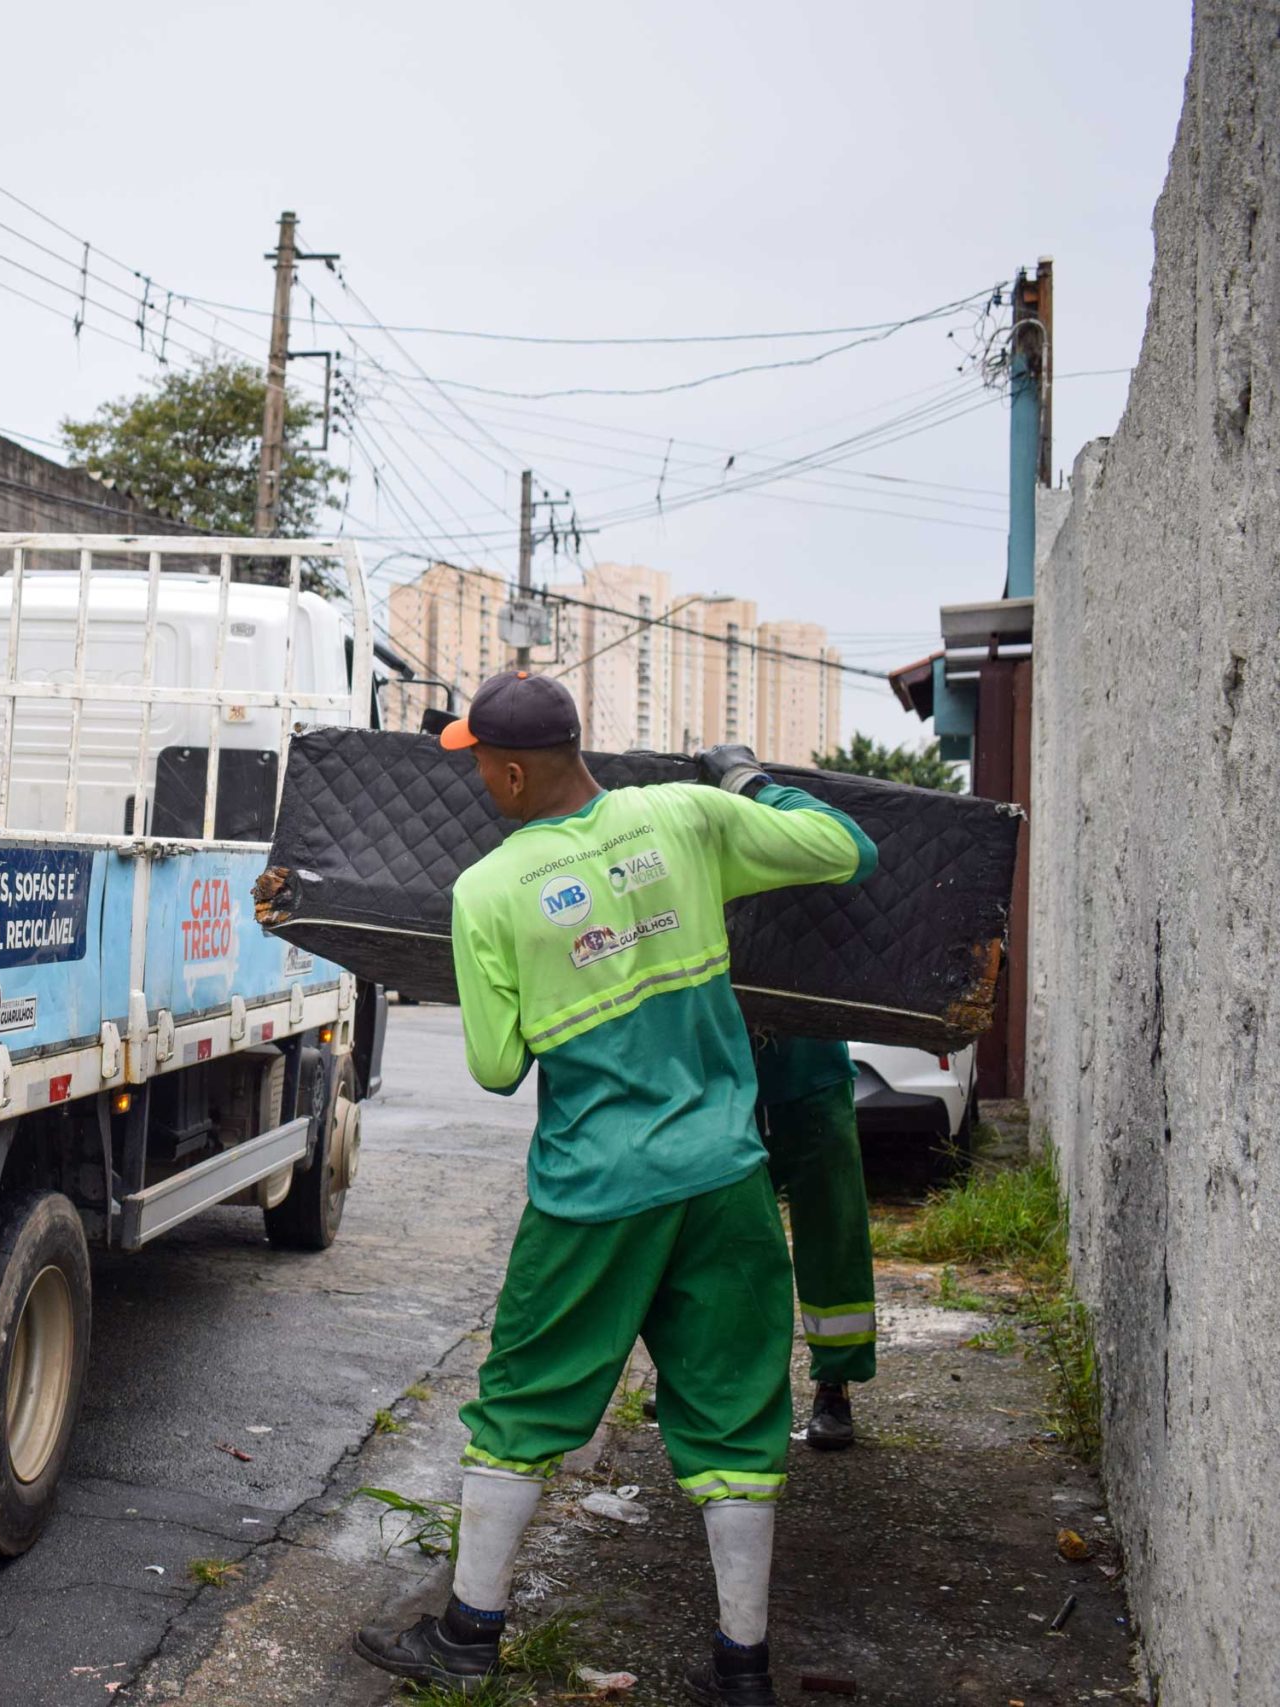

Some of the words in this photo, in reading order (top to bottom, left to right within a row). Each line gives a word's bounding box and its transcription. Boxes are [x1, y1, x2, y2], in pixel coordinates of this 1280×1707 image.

[625, 851, 662, 875] VALE
[630, 864, 666, 884] NORTE
[15, 865, 55, 902] SOFÁS
[190, 879, 230, 919] CATA
[544, 885, 585, 914] MB
[6, 911, 74, 949] RECICLÁVEL
[182, 918, 231, 961] TRECO
[620, 916, 674, 945] GUAULHOS
[0, 1007, 33, 1025] GUARULHOS
